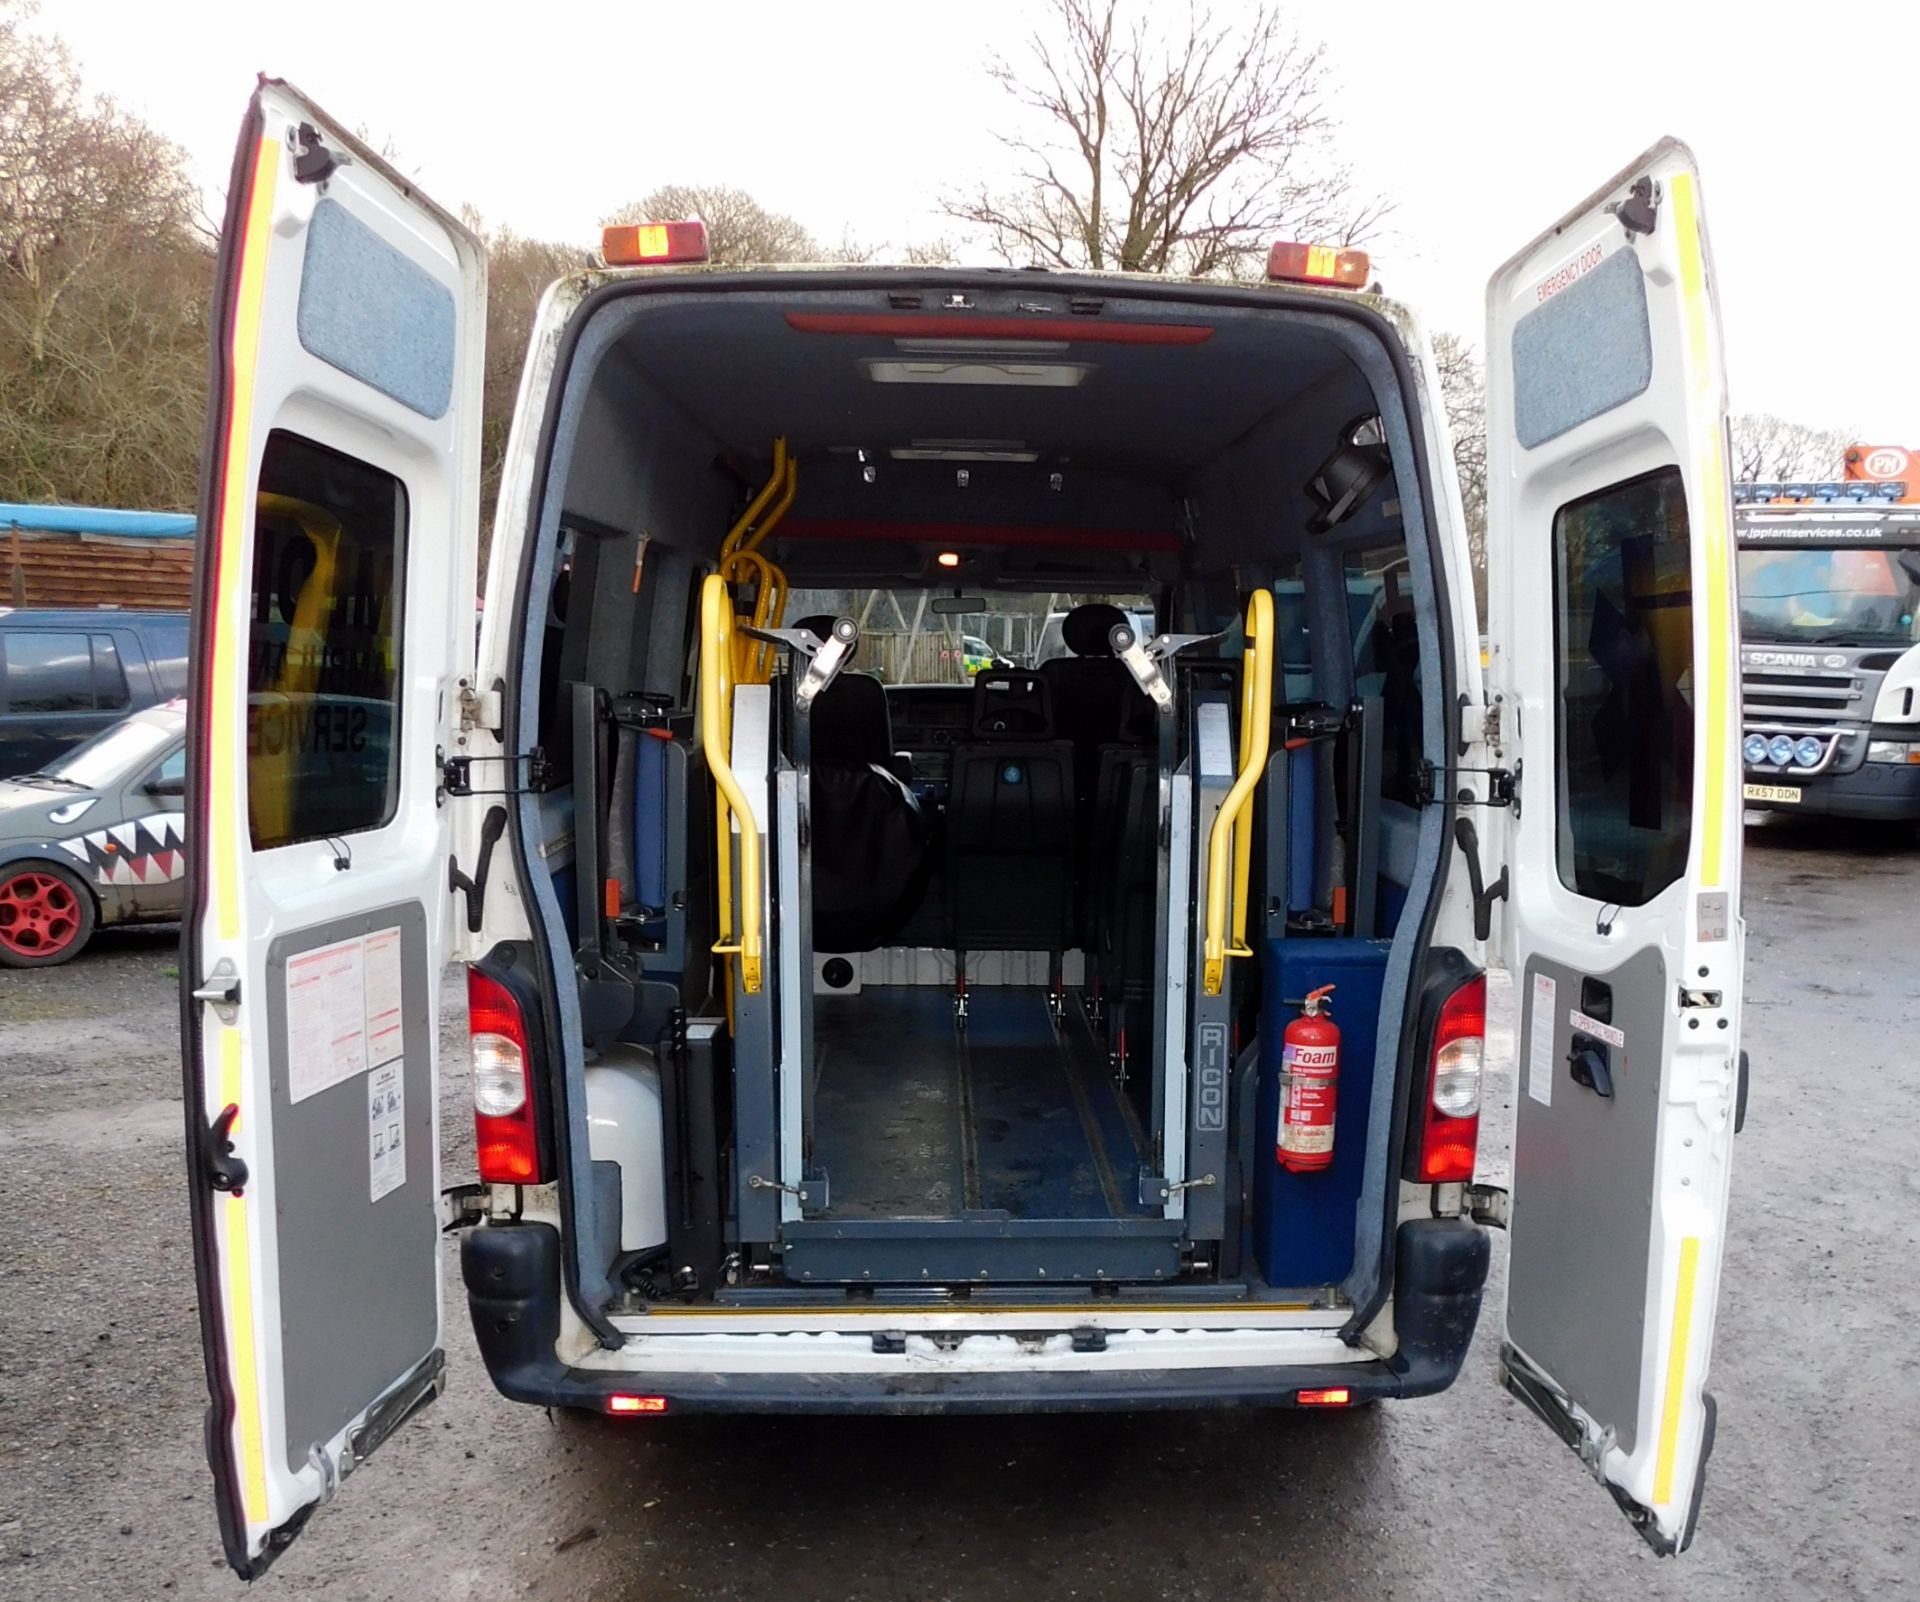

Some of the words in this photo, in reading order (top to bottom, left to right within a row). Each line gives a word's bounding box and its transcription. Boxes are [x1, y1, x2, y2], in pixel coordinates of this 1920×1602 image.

[1537, 258, 1580, 301] EMERGENCY
[1581, 243, 1603, 273] DOOR
[1750, 652, 1817, 667] SCANIA
[1747, 786, 1774, 798] RX57
[1295, 1047, 1335, 1065] Foam
[1201, 1027, 1222, 1126] RICON
